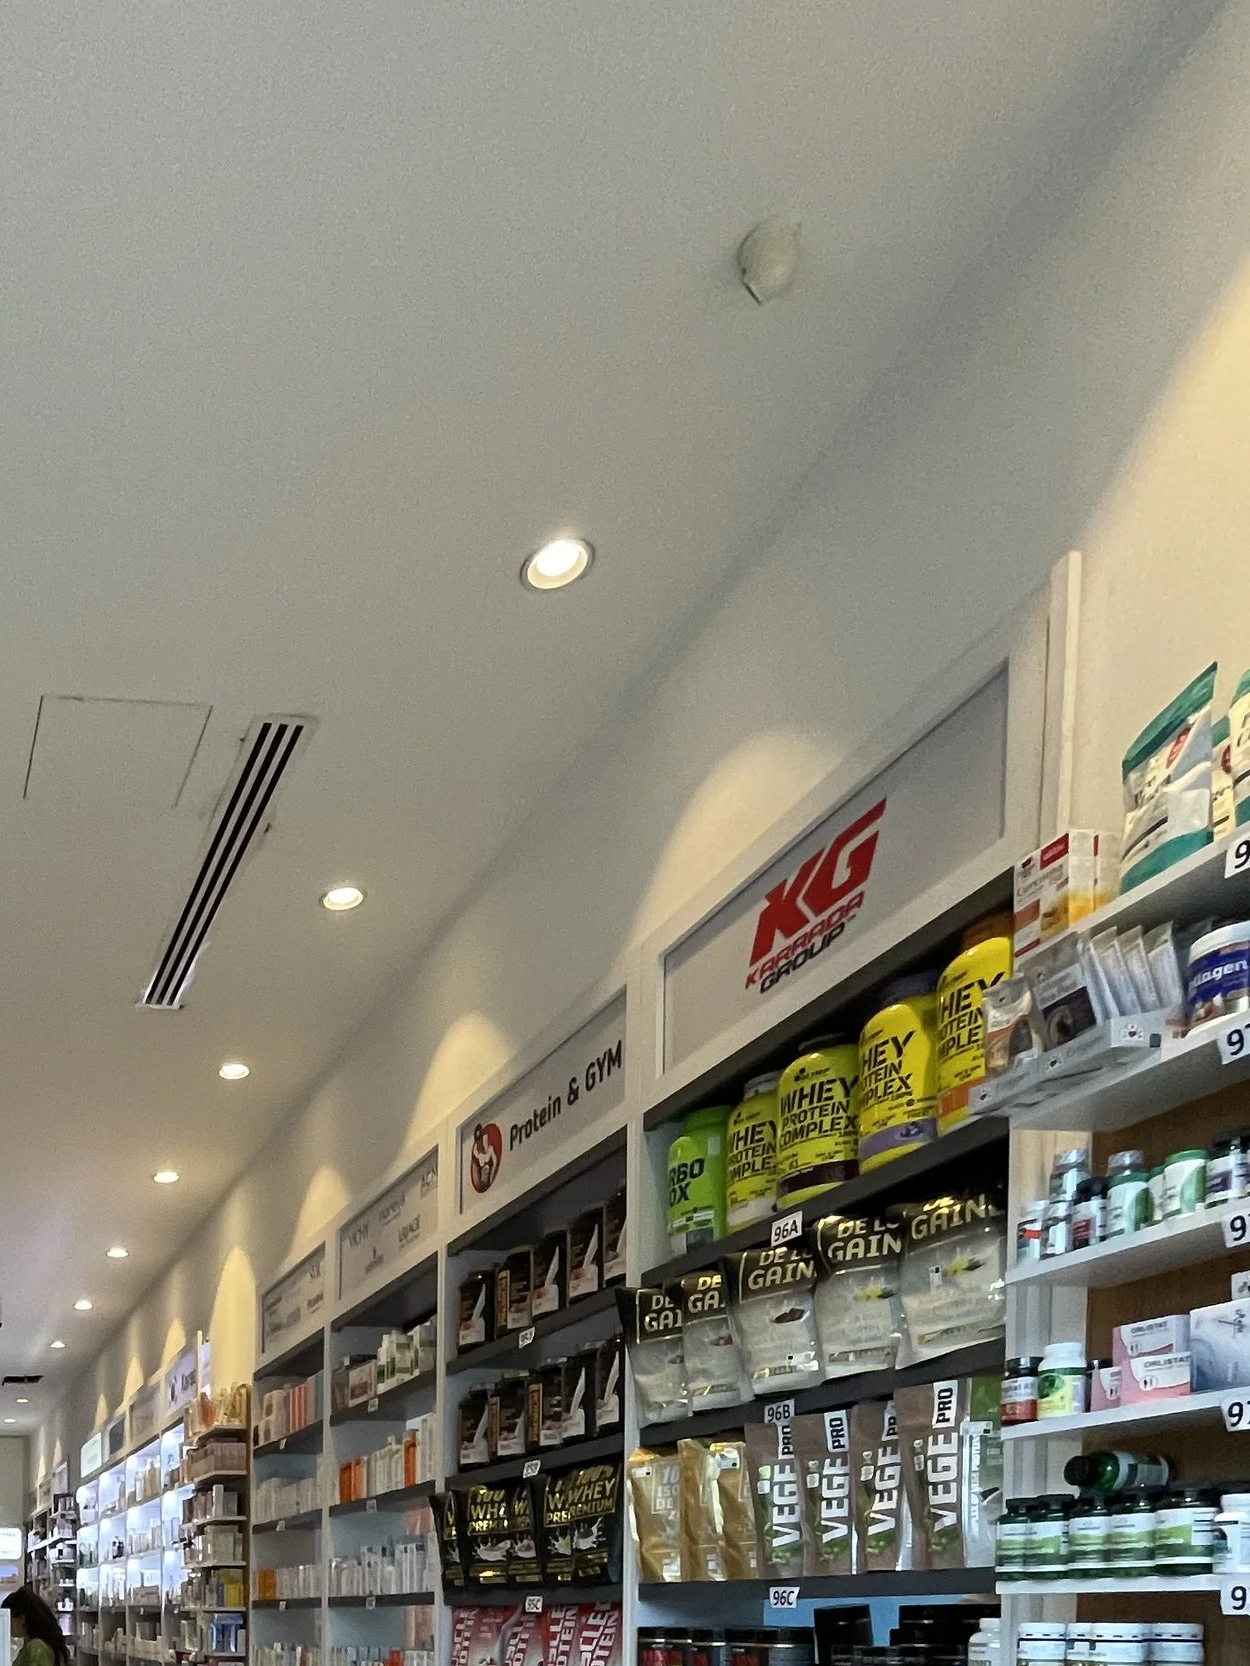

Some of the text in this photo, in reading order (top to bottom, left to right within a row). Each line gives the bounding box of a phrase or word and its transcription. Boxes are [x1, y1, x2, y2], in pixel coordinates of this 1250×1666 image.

[1234, 839, 1250, 869] 9
[759, 921, 845, 994] GROUP
[941, 971, 1005, 1021] HEY
[862, 1031, 915, 1075] HEY
[510, 1039, 622, 1151] Protein & GYM
[780, 1075, 860, 1116] WHEY
[782, 1101, 850, 1129] PROTEIN
[779, 1116, 858, 1148] COMPLEX
[774, 1219, 799, 1243] 96A
[911, 1194, 1000, 1241] GAIN
[748, 1260, 817, 1290] GAIN
[758, 1246, 788, 1266] DE
[767, 1403, 791, 1422] 96B
[821, 1417, 849, 1544] VEGE PRO
[927, 1386, 958, 1533] VEGE PRO
[772, 1465, 800, 1548] VEGE
[868, 1446, 901, 1536] VEGE
[772, 1591, 795, 1606] 96C
